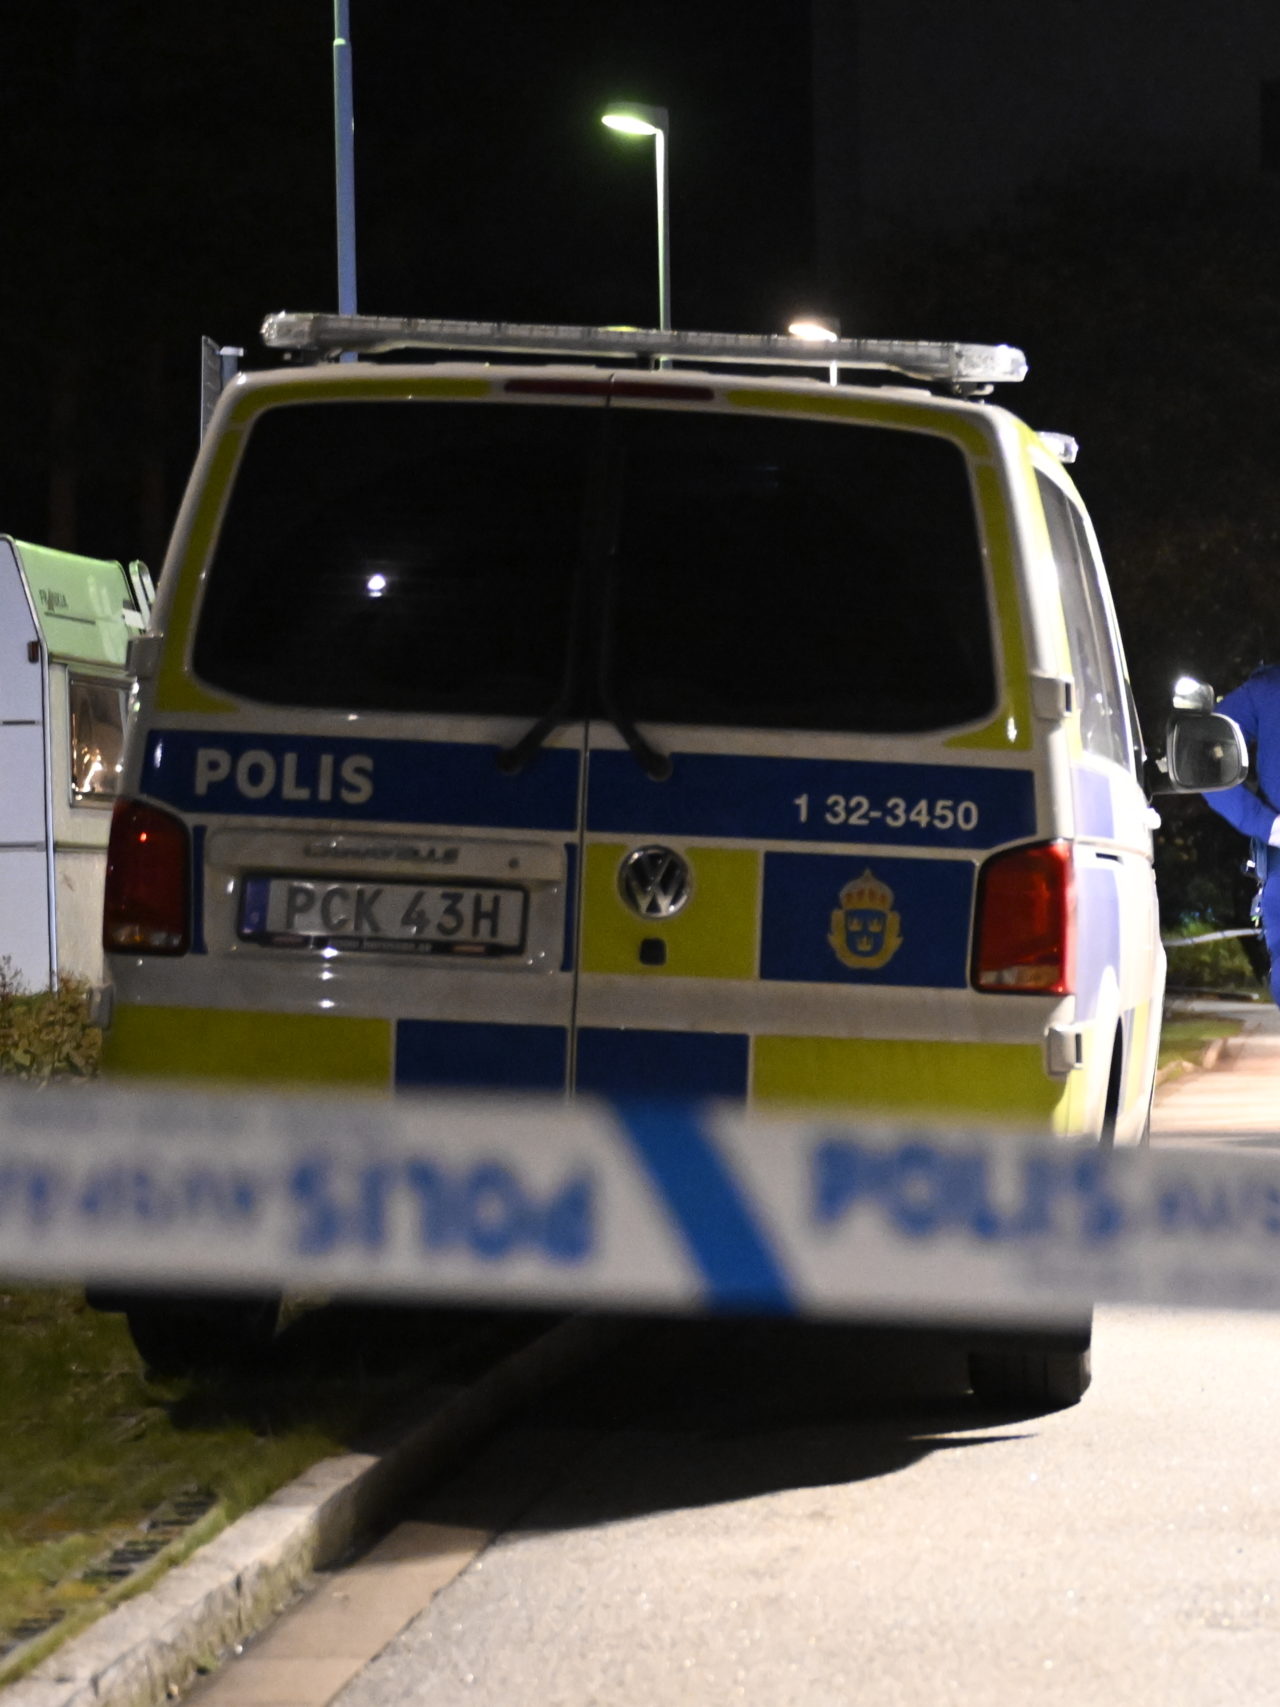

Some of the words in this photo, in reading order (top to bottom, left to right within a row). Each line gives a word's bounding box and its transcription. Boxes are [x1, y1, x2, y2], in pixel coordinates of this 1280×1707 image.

[194, 747, 375, 803] POLIS
[793, 793, 809, 823] 1
[825, 795, 979, 831] 32-3450
[285, 882, 384, 933] PCK
[401, 889, 500, 938] 43H
[291, 1153, 597, 1267] POLIS
[813, 1134, 1127, 1241] POLIS
